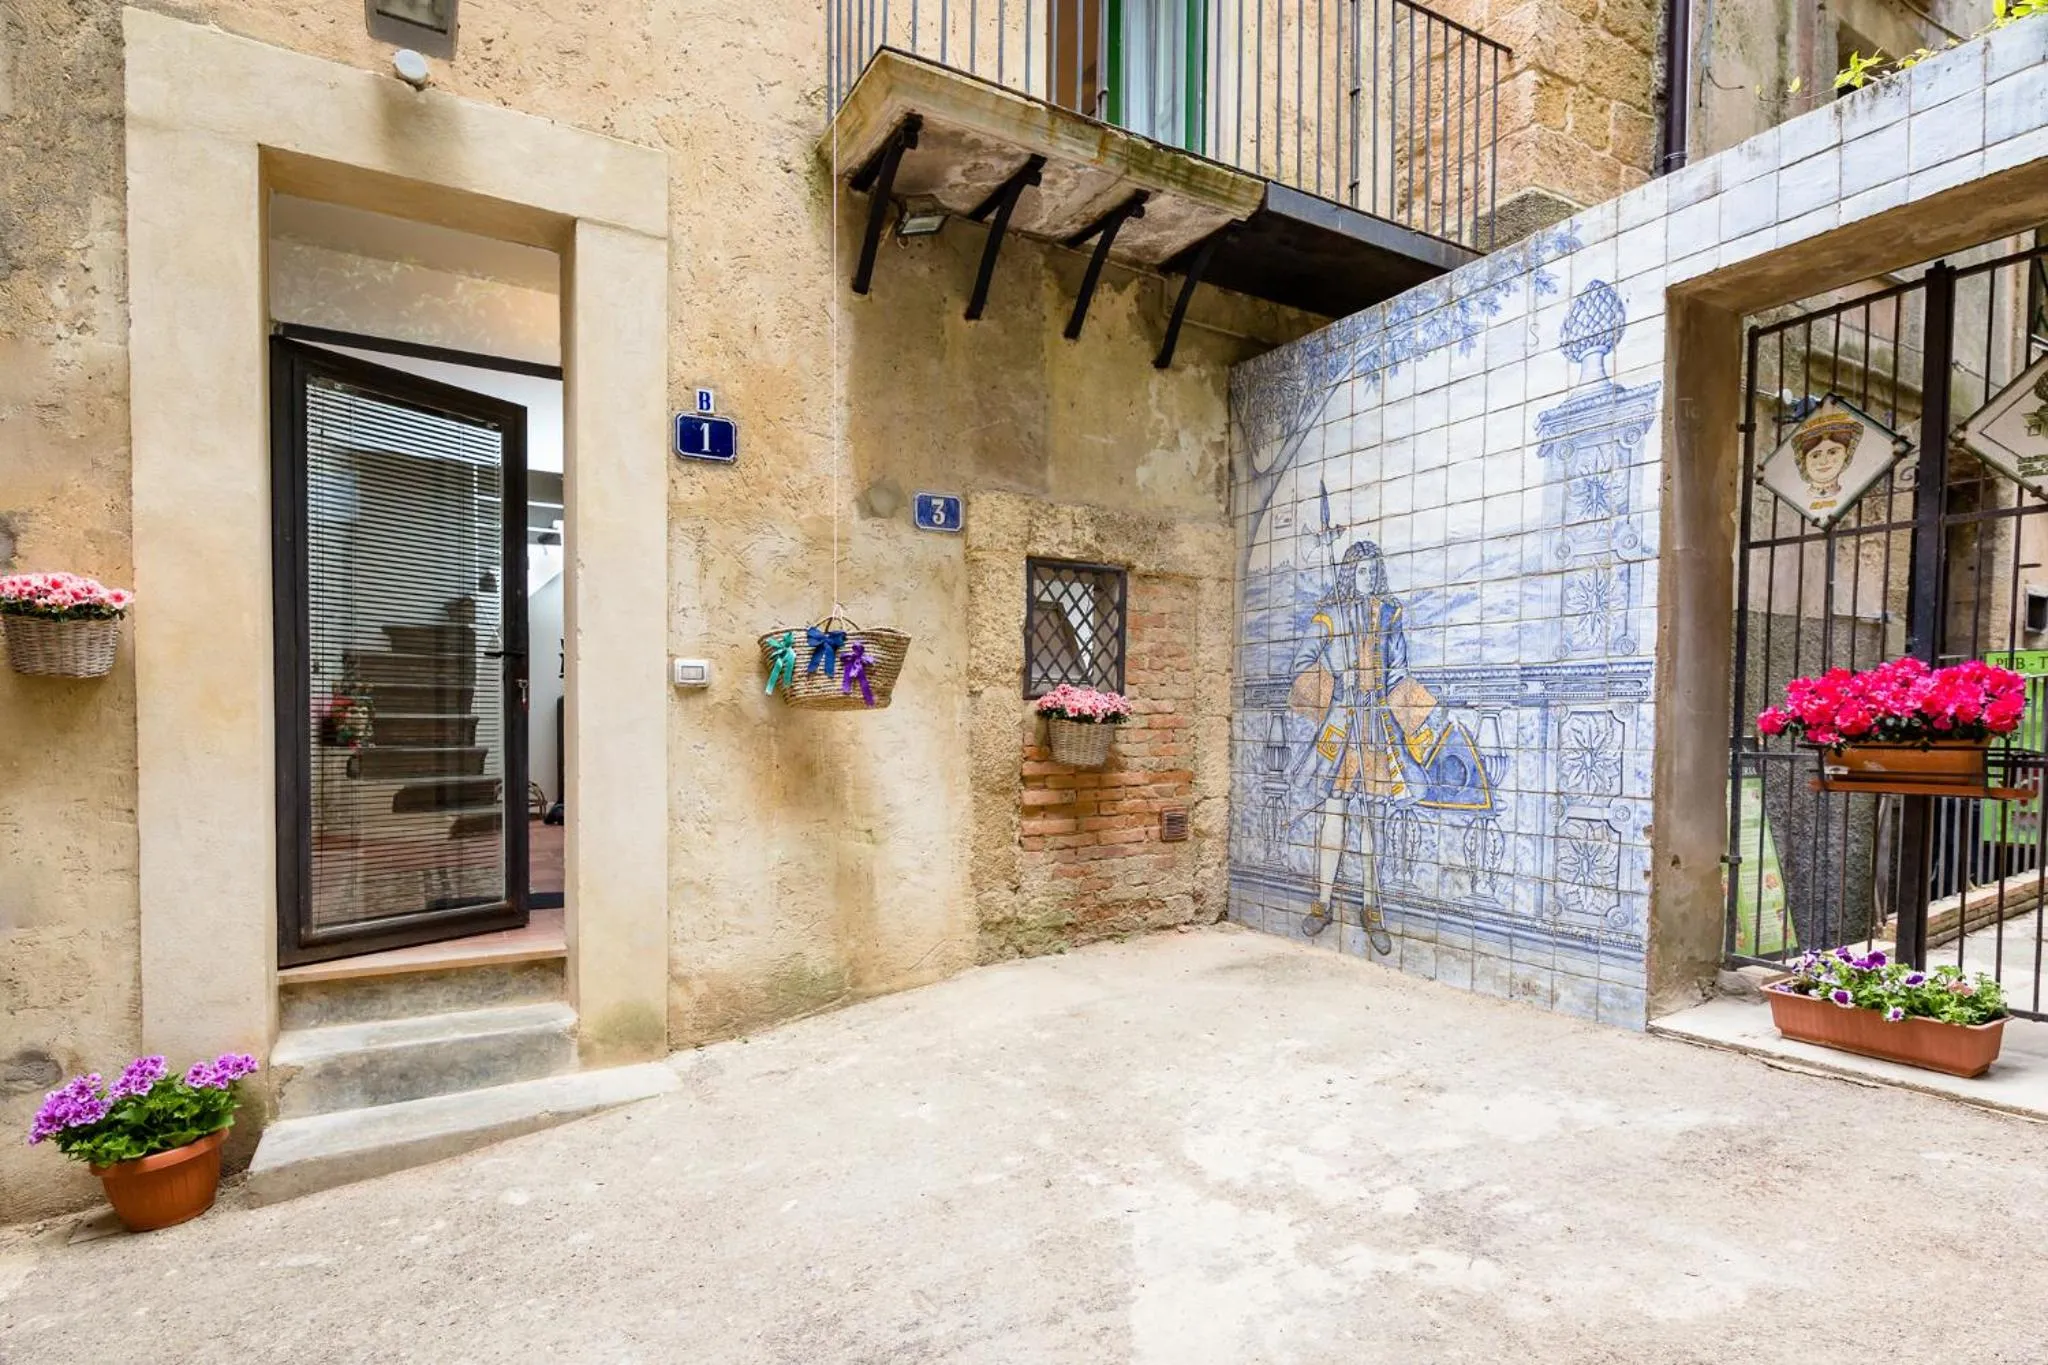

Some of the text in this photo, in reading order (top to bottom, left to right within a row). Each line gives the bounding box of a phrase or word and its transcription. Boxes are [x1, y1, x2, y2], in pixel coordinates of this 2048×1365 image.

[698, 391, 711, 411] B
[700, 422, 711, 452] 1
[931, 498, 946, 525] 3
